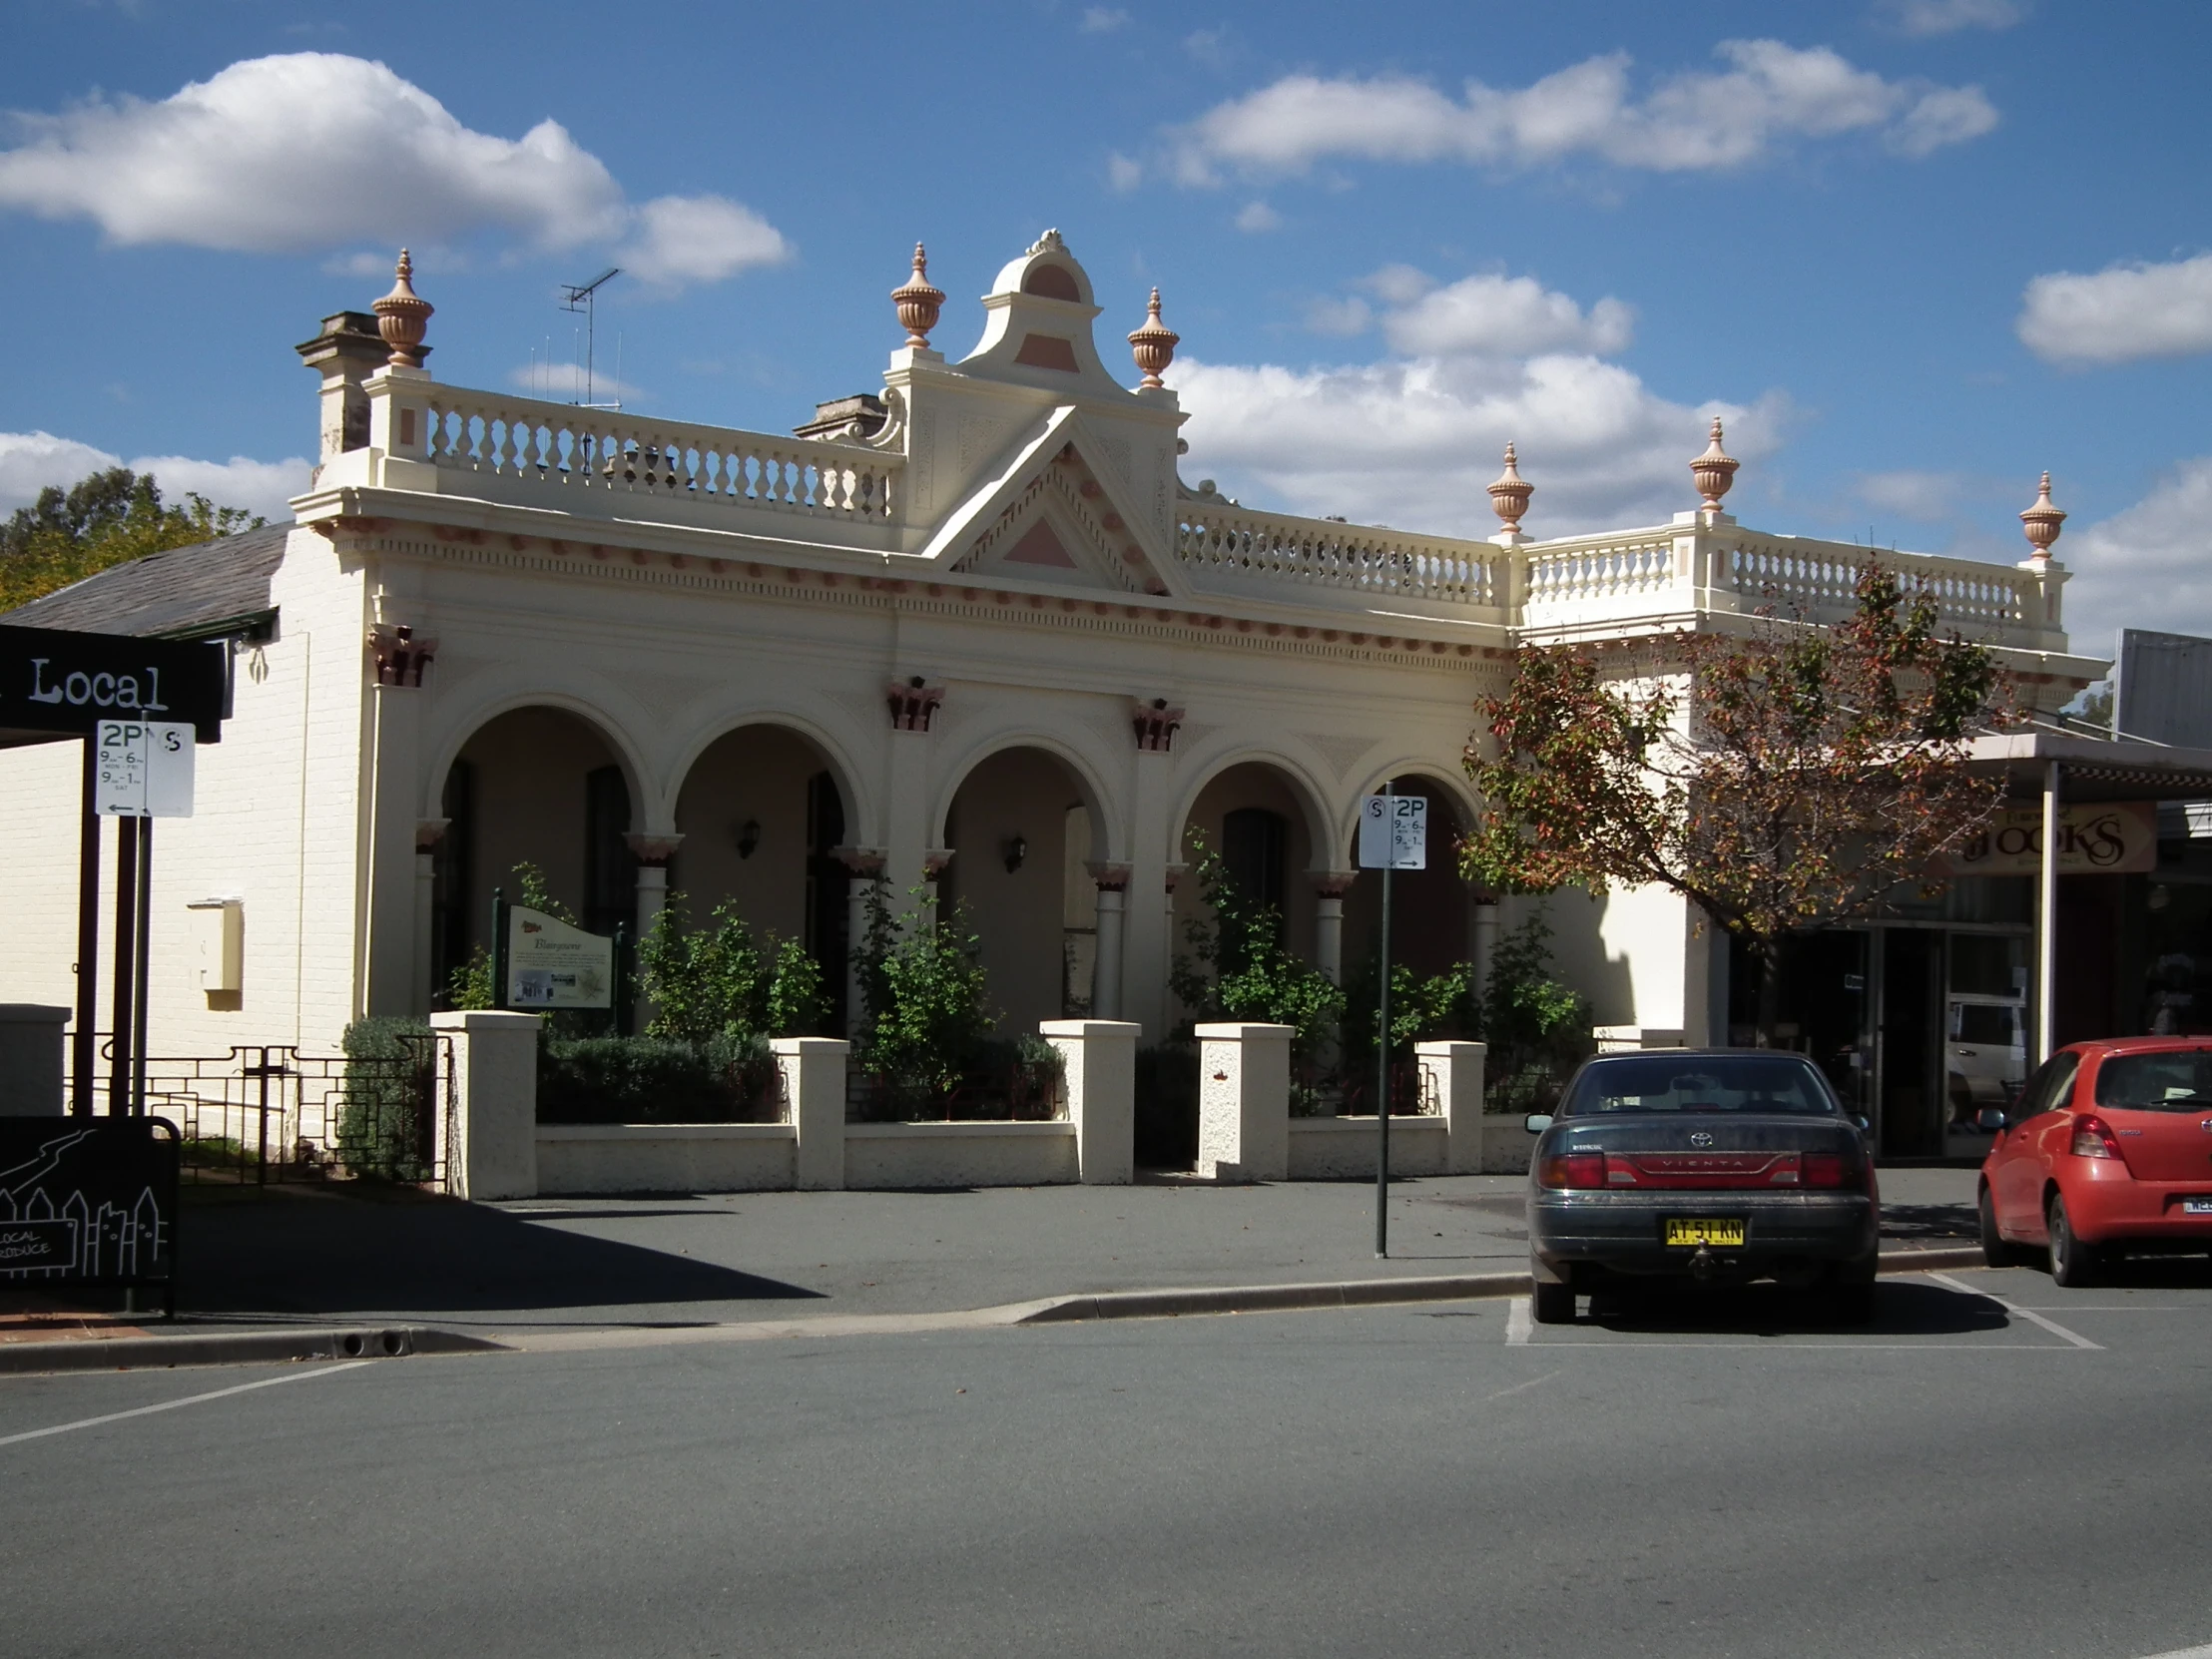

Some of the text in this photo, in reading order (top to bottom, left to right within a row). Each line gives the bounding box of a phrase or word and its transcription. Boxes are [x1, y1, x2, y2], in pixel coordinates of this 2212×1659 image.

[29, 659, 169, 711] Local
[104, 725, 142, 747] 2P
[1396, 800, 1424, 817] 2P
